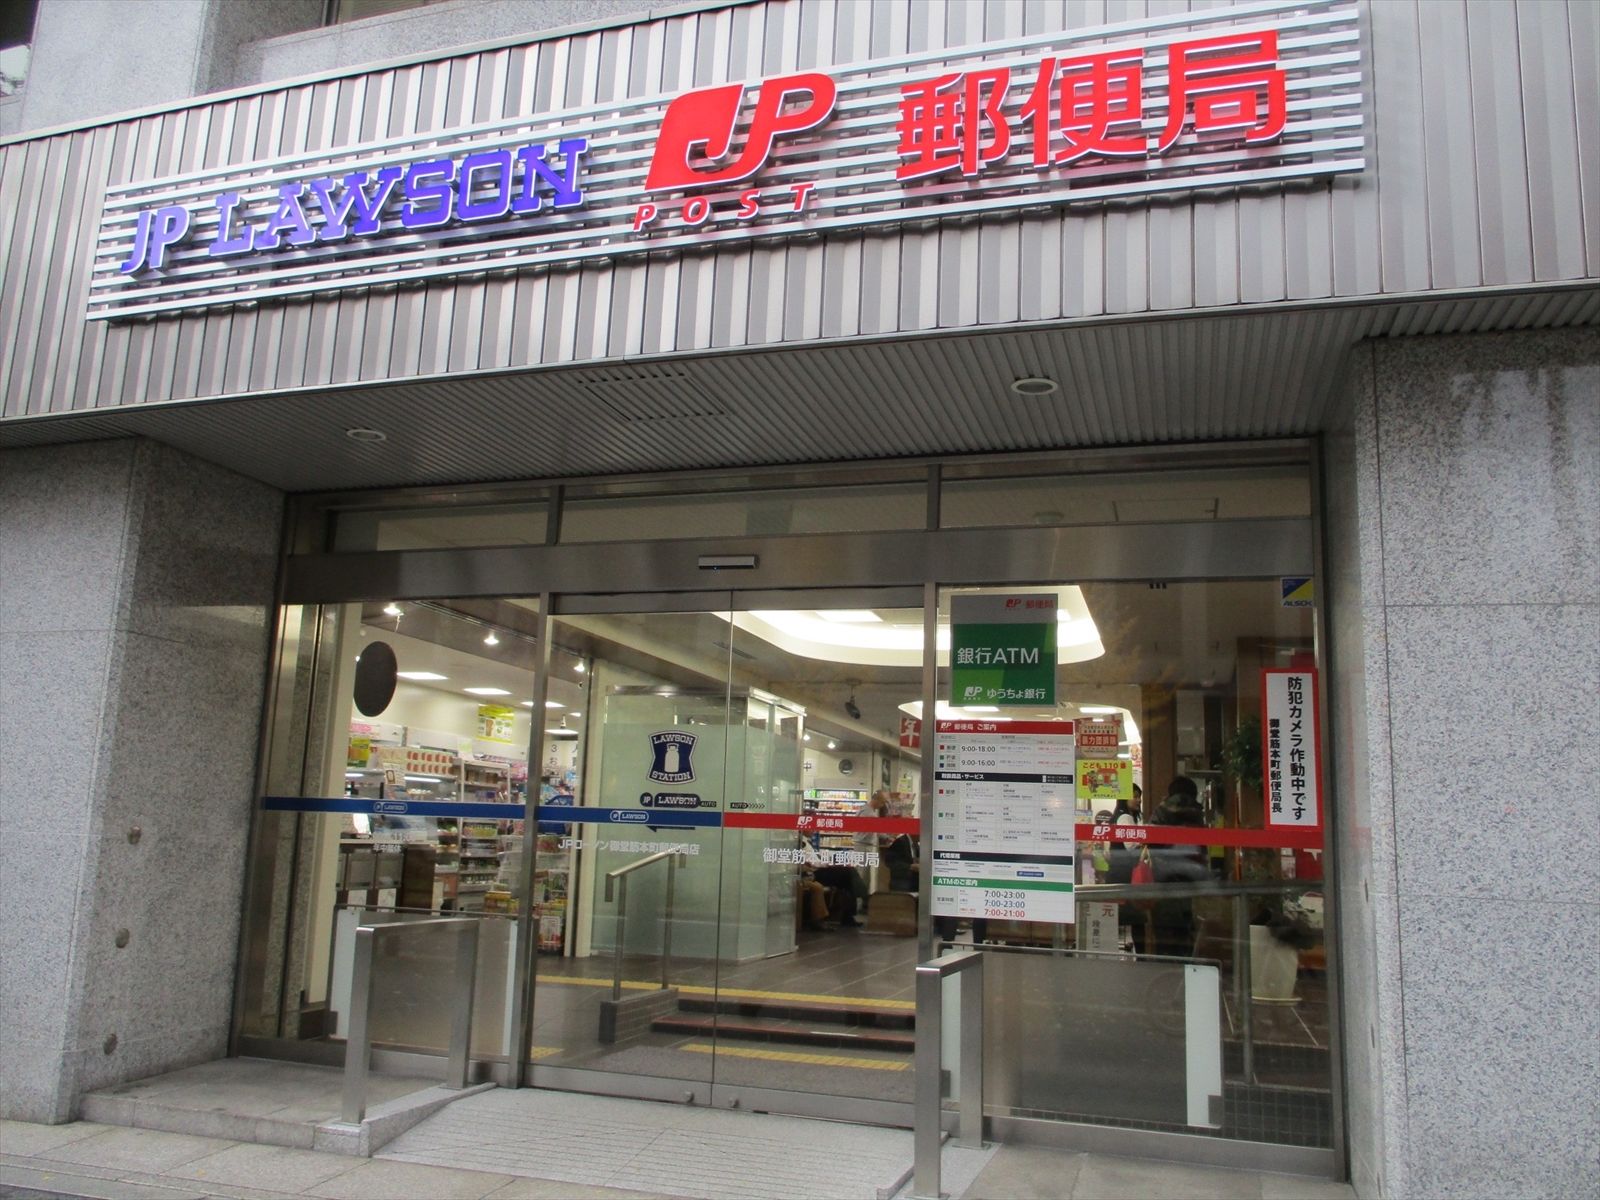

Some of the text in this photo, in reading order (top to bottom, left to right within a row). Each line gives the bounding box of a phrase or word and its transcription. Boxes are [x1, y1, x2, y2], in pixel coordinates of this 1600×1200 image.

[896, 29, 1287, 181] 郵便局
[121, 138, 588, 275] JP LAWSON
[632, 181, 818, 232] POST
[957, 648, 1039, 664] 銀行ATM
[987, 688, 1046, 699] ゆうちょ銀行
[652, 733, 694, 745] LAWSON
[1287, 676, 1306, 821] 防犯カメラ作動中です
[1269, 718, 1282, 814] 御堂筋本町郵便局長
[650, 770, 691, 782] STATION
[642, 796, 697, 806] JP LAWSON
[816, 818, 844, 829] 郵便局
[1115, 828, 1147, 840] 郵便局
[763, 847, 880, 868] 御堂筋本町郵便局
[984, 890, 1025, 899] 7:00-23:00
[984, 899, 1025, 909] 7:00-23:00
[984, 908, 1025, 918] 7:00-21:00
